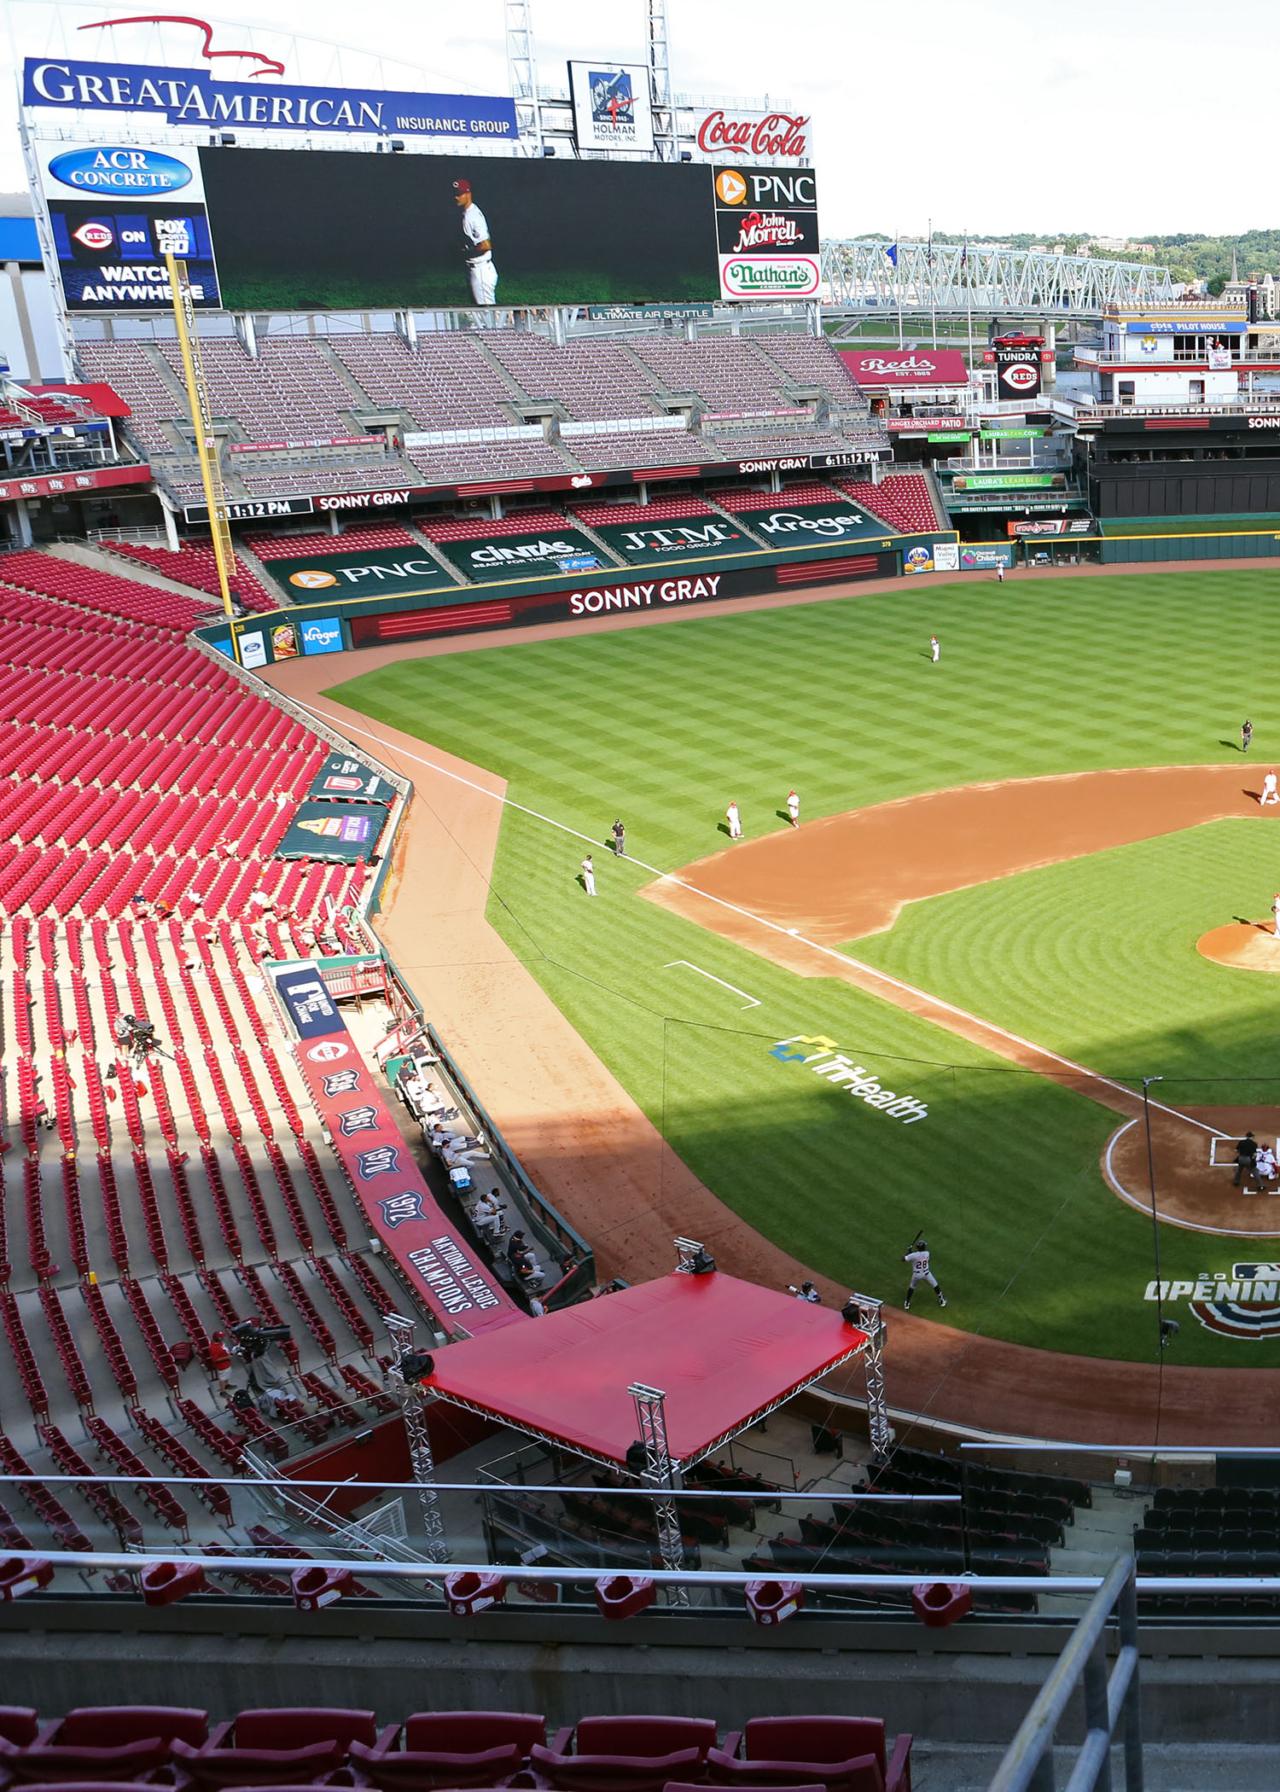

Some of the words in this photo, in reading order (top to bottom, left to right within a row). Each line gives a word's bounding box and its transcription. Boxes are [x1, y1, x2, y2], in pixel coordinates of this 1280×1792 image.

[32, 64, 188, 107] GREAT
[177, 85, 383, 129] AMERICAN
[396, 116, 467, 131] INSURANCE
[471, 119, 510, 133] GROUP
[593, 124, 635, 134] HOLMAN
[698, 111, 811, 156] Coca-Cola
[93, 151, 147, 170] ACR
[70, 170, 171, 187] CONCRETE
[750, 175, 815, 203] PNC
[154, 220, 186, 234] FOX
[758, 213, 785, 228] John
[121, 231, 146, 243] ON
[733, 221, 804, 252] Morrell
[159, 240, 189, 254] GO
[730, 264, 811, 284] Nathan's
[592, 311, 642, 320] ULTIMATE
[664, 310, 708, 318] SHUTTLE
[860, 356, 936, 374] Reds
[998, 352, 1038, 362] TUNDRA
[941, 420, 961, 428] PATIO
[739, 461, 778, 474] SONNY
[780, 458, 808, 470] GRAY
[826, 453, 862, 466] 6:11:12
[864, 452, 880, 462] PM
[571, 475, 592, 488] Reds
[319, 494, 371, 511] SONNY
[373, 491, 410, 505] GRAY
[214, 503, 264, 519] :11:12
[268, 502, 292, 514] PM
[759, 513, 863, 536] Kroger
[655, 544, 685, 553] FOOD
[686, 541, 722, 550] GROUP
[506, 558, 524, 566] FOR
[525, 556, 545, 564] THE
[548, 551, 592, 561] WORKDAY
[976, 554, 1008, 562] Children's
[335, 560, 438, 583] PNC
[570, 584, 655, 614] SONNY
[660, 576, 721, 602] GRAY
[303, 627, 340, 645] Kroger
[811, 1055, 928, 1124] TriHealth
[345, 1108, 374, 1130] 1961
[364, 1148, 392, 1174] 1970
[386, 1194, 416, 1222] 1972
[409, 1248, 472, 1314] CHAMPIONS
[432, 1236, 472, 1276] NATIONAL
[460, 1274, 499, 1309] LEAGUE
